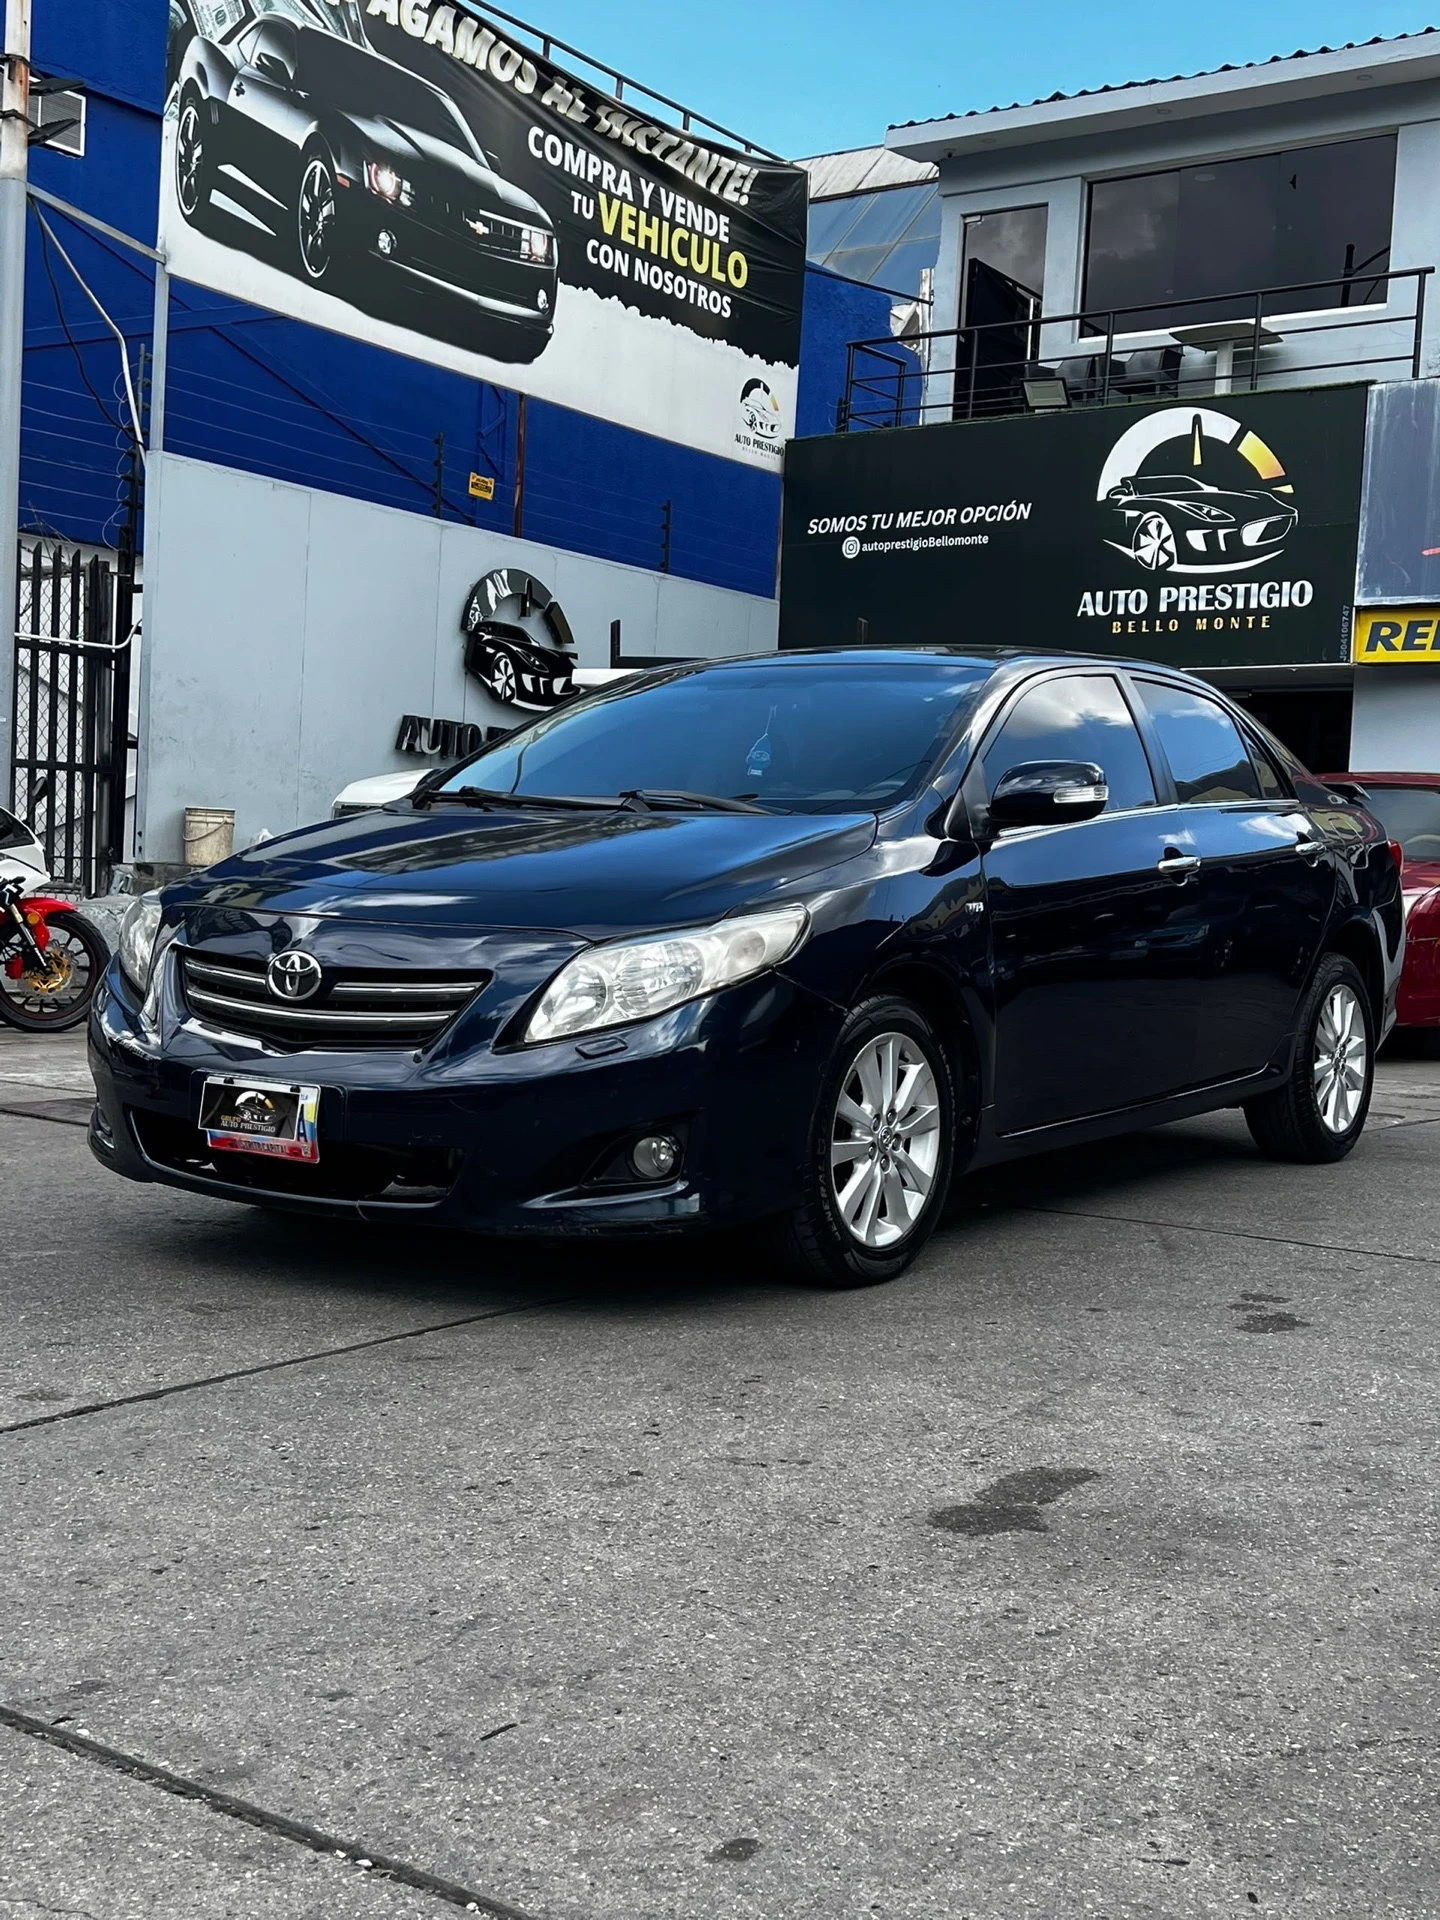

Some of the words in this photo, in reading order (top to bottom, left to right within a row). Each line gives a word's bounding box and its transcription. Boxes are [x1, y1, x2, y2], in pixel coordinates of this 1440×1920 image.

[326, 0, 538, 94] AGAMOS
[541, 75, 590, 123] AL
[528, 126, 634, 201] COMPRA
[639, 177, 655, 209] Y
[659, 186, 730, 244] VENDE
[571, 190, 594, 220] TU
[598, 191, 748, 289] VEHICULO
[586, 238, 629, 277] CON
[634, 257, 732, 319] NOSOTROS
[734, 433, 751, 446] AUTO
[753, 439, 784, 457] PRESTIGIO
[807, 515, 868, 535] SOMOS
[871, 513, 893, 530] TU
[895, 508, 957, 529] MEJOR
[960, 500, 1033, 524] OPCIÓN
[862, 533, 989, 553] autoprestigioBellomonte
[1077, 588, 1148, 617] AUTO
[1159, 580, 1313, 613] PRESTIGIO
[1112, 618, 1179, 634] BELLO
[1195, 615, 1271, 631] MONTE
[1365, 620, 1440, 652] RE
[395, 715, 484, 760] AUTO
[221, 1121, 239, 1129] AUTO
[240, 1122, 276, 1133] PRESTIGIO
